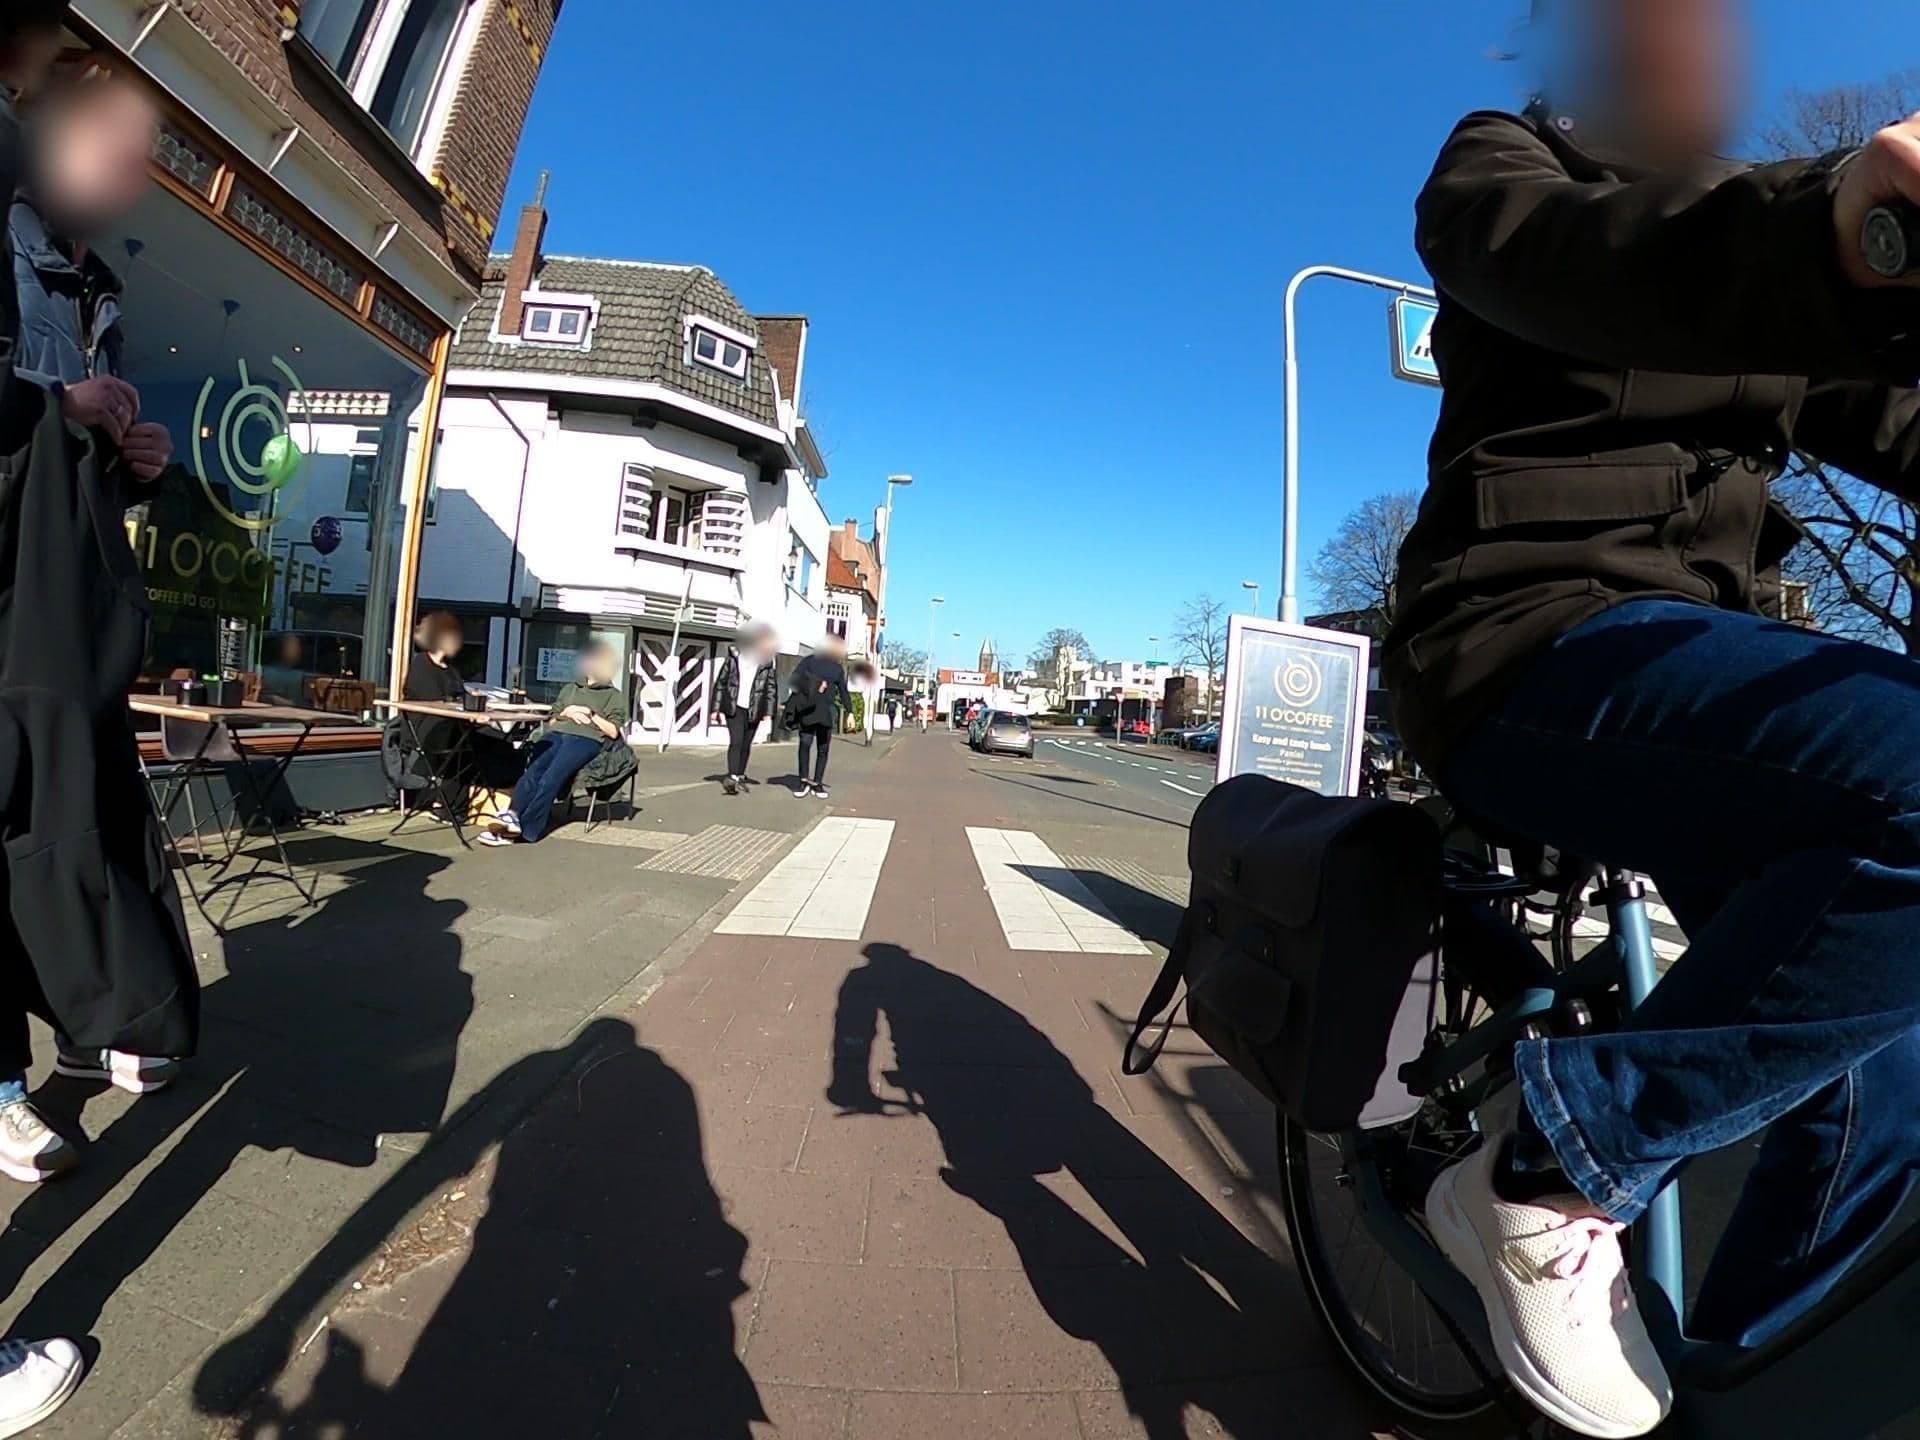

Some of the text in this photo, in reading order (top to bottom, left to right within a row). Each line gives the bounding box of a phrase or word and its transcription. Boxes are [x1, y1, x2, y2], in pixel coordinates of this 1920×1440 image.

[144, 586, 184, 605] OFFEE
[1256, 705, 1333, 728] 11 O'COFFEE
[1253, 734, 1271, 745] Easy
[1272, 737, 1288, 746] and
